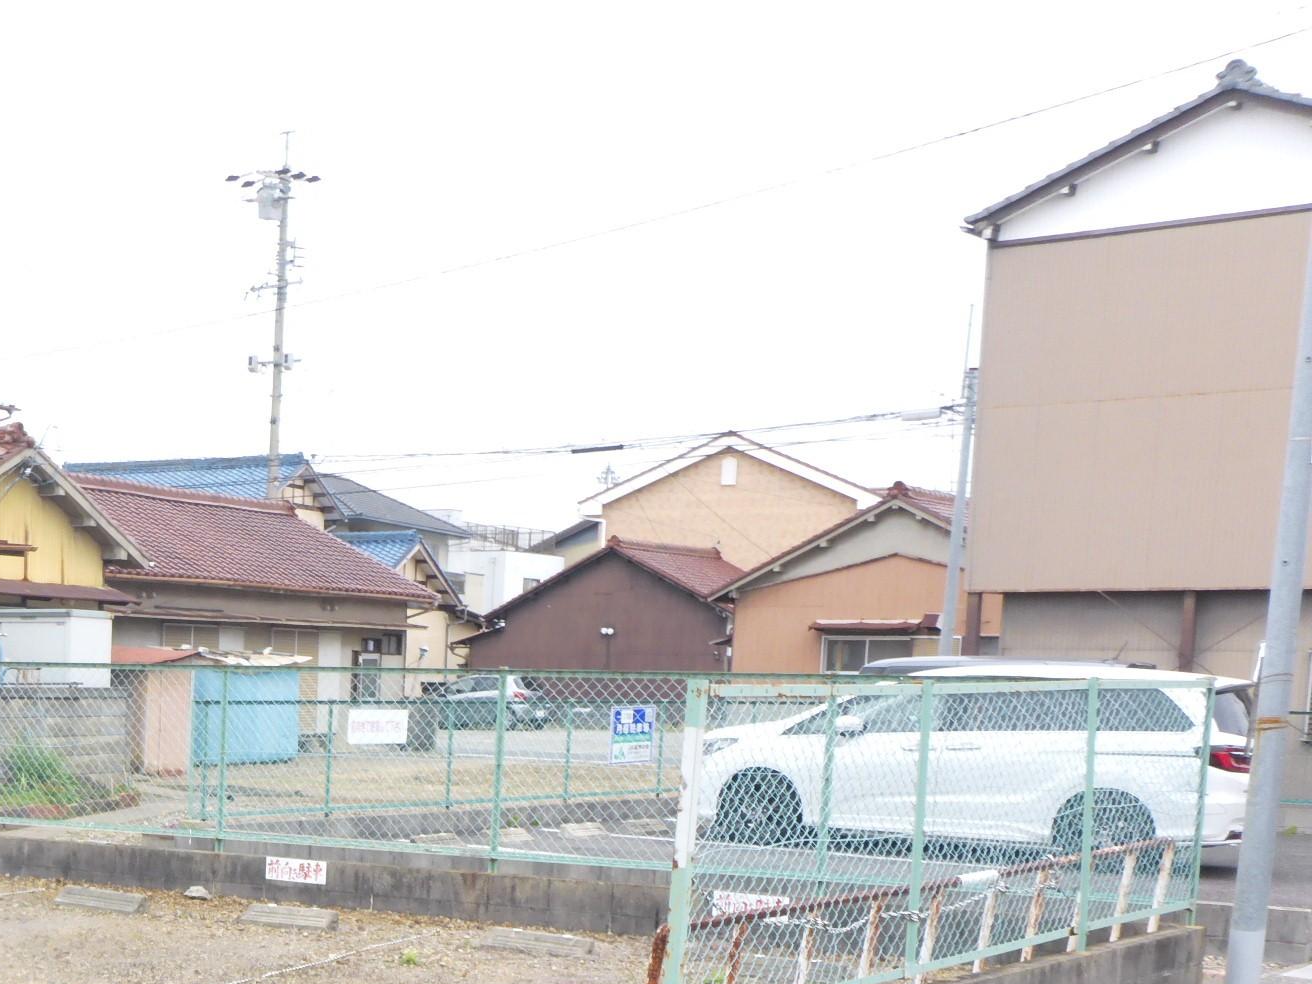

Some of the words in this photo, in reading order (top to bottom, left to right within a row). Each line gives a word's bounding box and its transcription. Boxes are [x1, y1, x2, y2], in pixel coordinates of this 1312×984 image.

[267, 859, 323, 881] 前向き駐車
